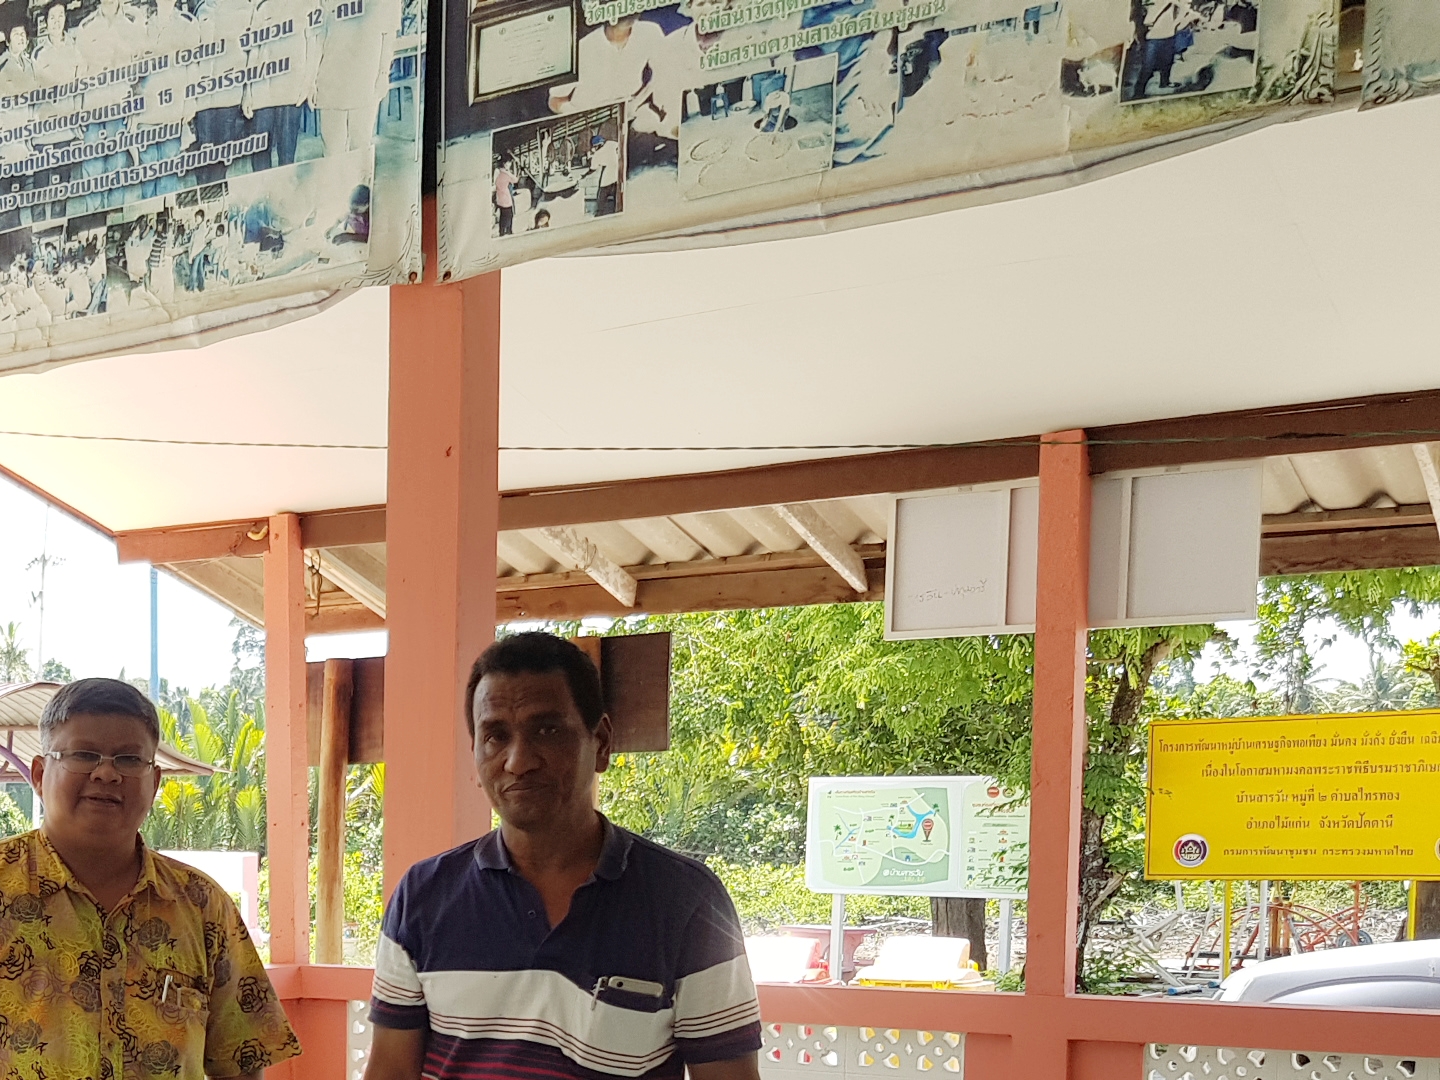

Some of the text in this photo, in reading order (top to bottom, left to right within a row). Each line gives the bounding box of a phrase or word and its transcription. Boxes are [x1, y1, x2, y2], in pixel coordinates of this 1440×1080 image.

[239, 19, 294, 49] จำนวน
[307, 9, 322, 27] 12
[336, 1, 363, 19] คน
[158, 88, 173, 106] 15
[1236, 789, 1288, 803] บ้านสารวัน
[1331, 787, 1400, 802] ตำบลไทรทอง
[1319, 812, 1393, 829] จังหวัดปัตตานี
